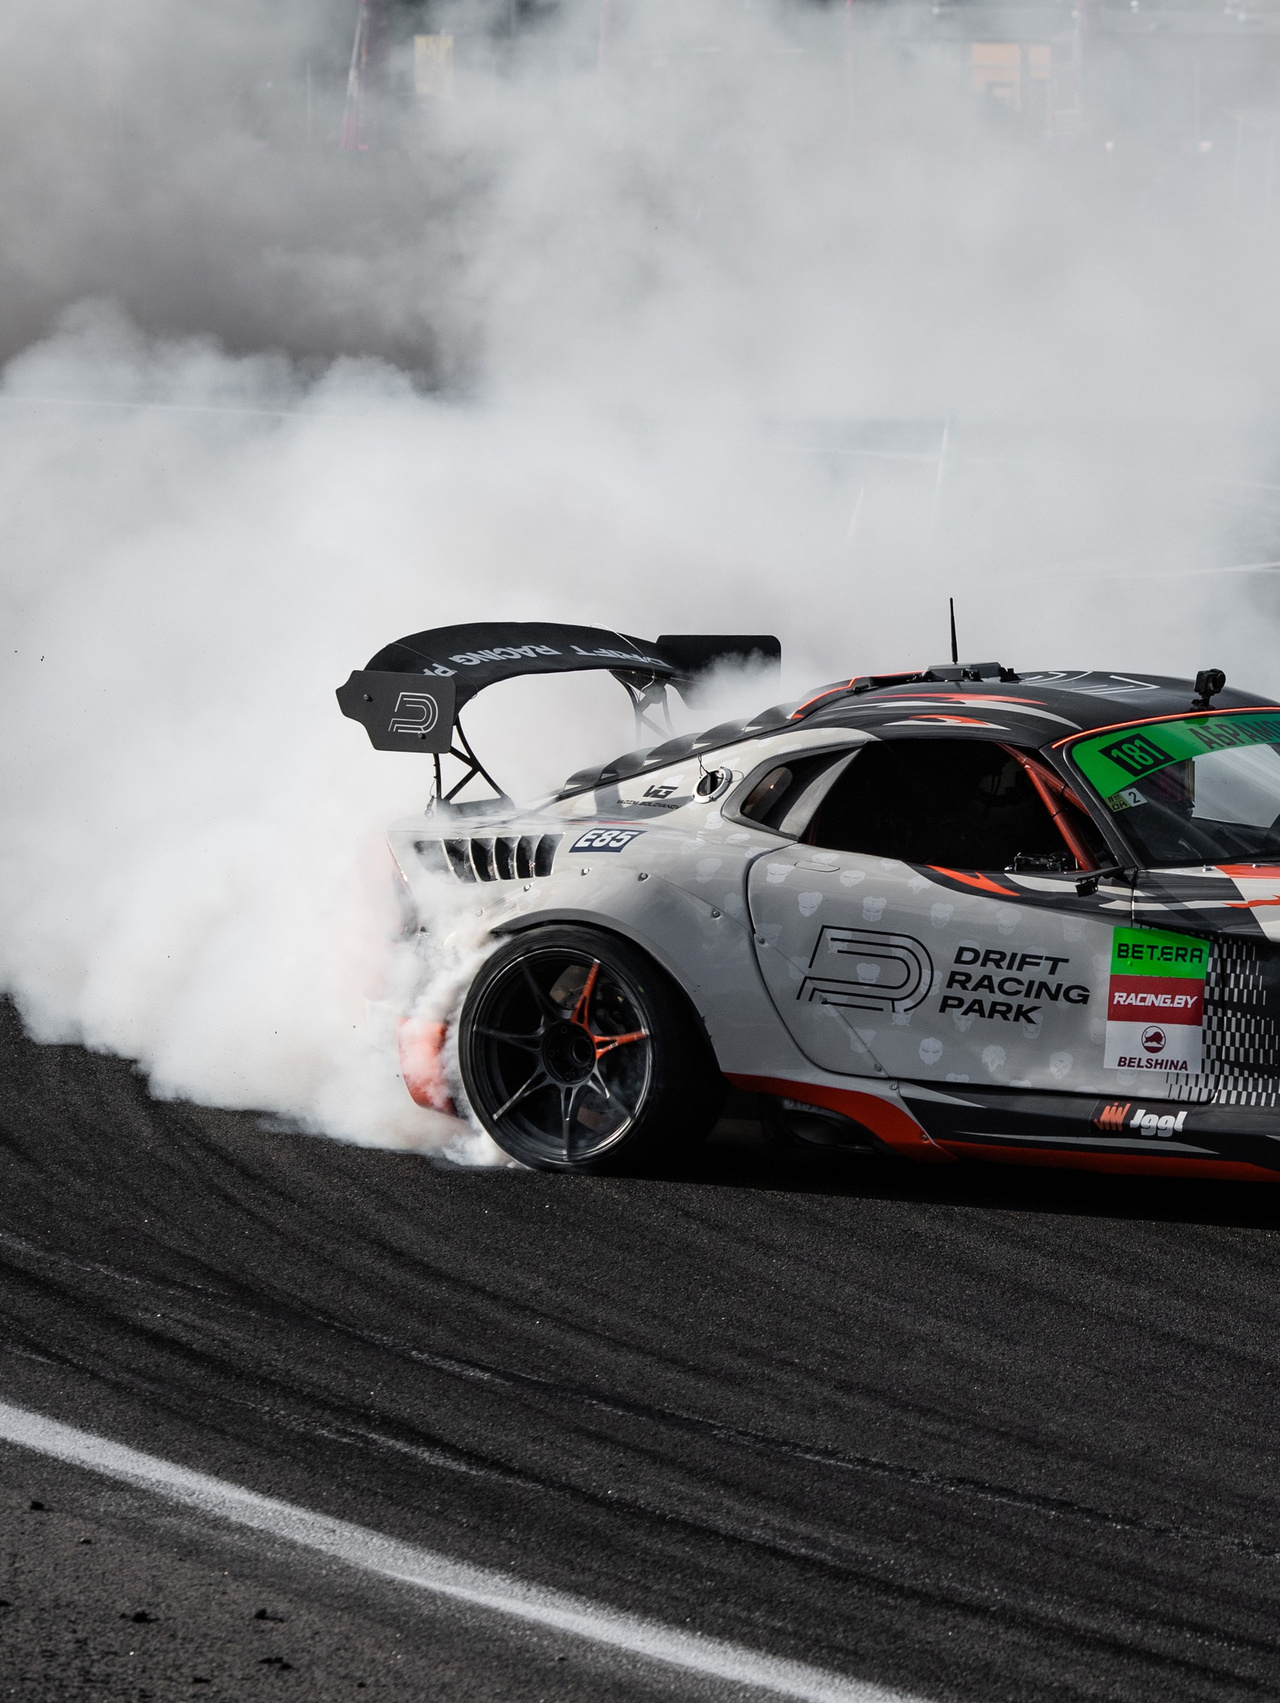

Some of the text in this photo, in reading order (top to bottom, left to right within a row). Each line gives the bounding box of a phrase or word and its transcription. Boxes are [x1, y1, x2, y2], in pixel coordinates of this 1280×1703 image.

[448, 644, 563, 666] RACING
[1111, 739, 1165, 771] 181
[1128, 791, 1142, 804] 2
[574, 829, 640, 848] E85
[953, 946, 1070, 976] DRIFT
[946, 970, 1091, 1005] RACING
[938, 995, 1043, 1025] PARK
[1113, 992, 1198, 1008] RACING.BY
[1117, 1056, 1189, 1071] BELSHINA
